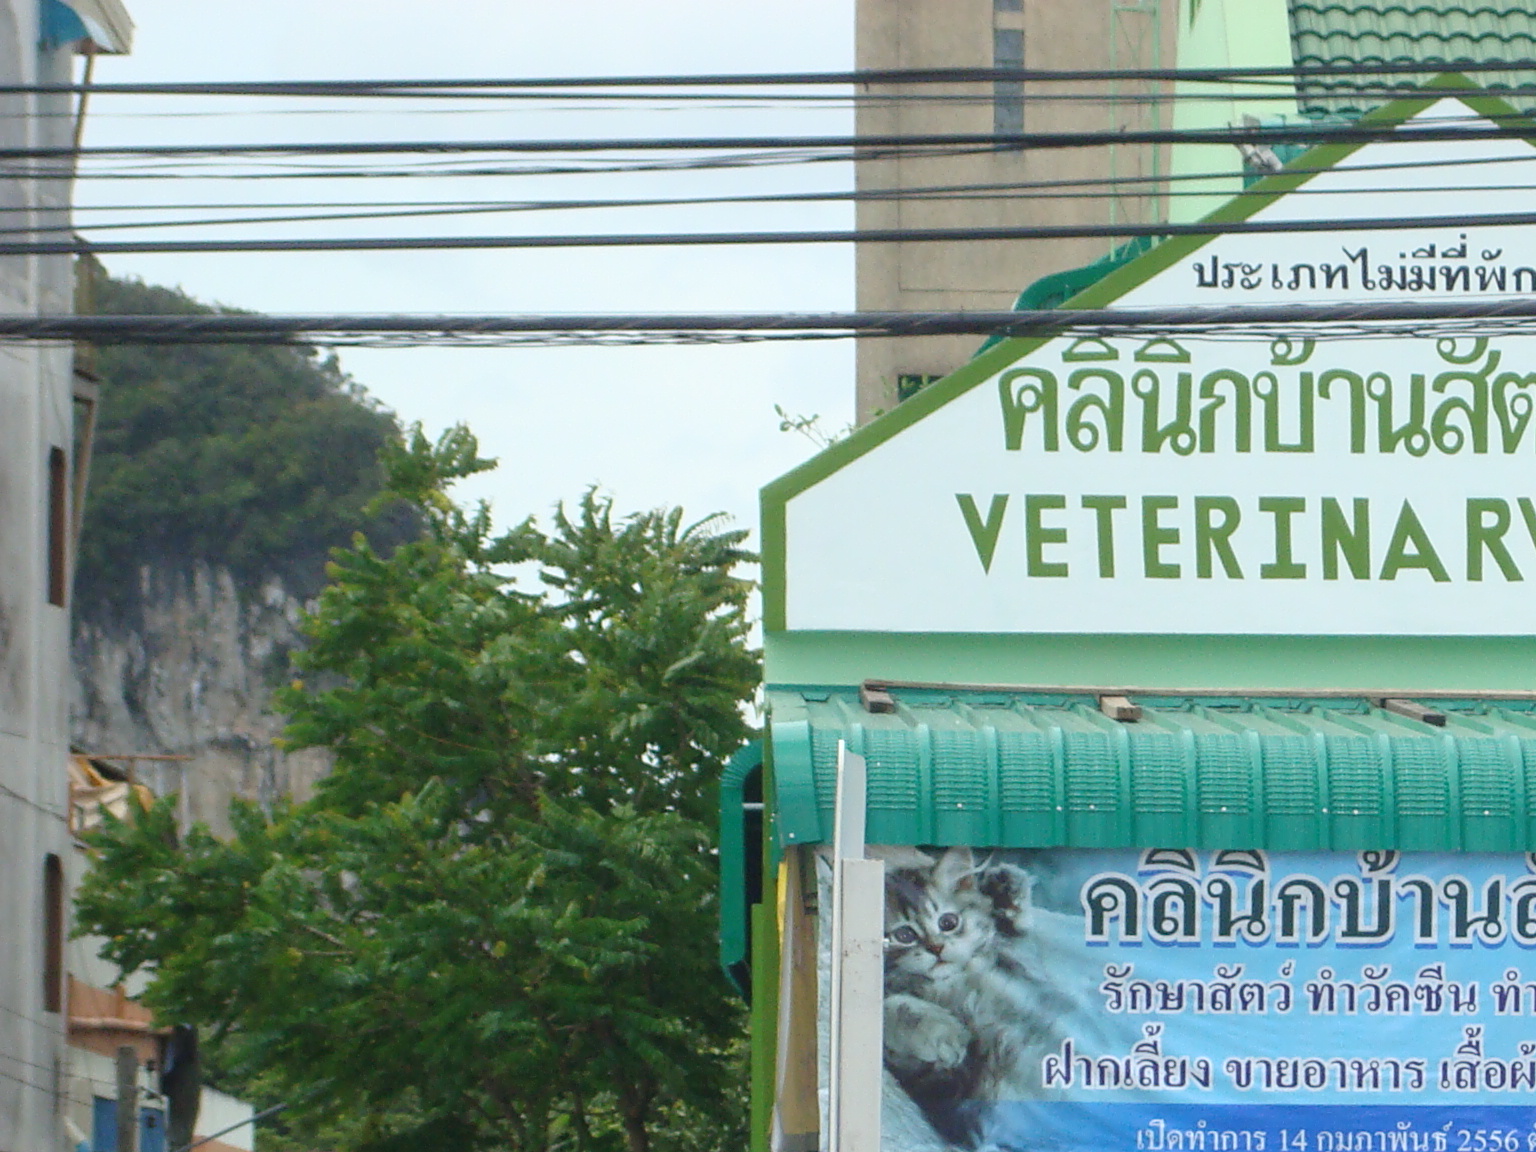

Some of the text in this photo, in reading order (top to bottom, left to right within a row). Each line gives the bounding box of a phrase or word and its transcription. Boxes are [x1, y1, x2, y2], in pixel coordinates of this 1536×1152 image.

[1102, 961, 1294, 1014] รักษาสัตว์
[1305, 964, 1478, 1014] ทำวัคซีน
[1042, 1023, 1212, 1090] ฝากเลี้ยง
[1225, 1055, 1427, 1091] ขายอาหาร
[1136, 1121, 1265, 1152] เปิดทำการ
[1279, 1130, 1306, 1150] 14
[1457, 1130, 1519, 1151] 2556
